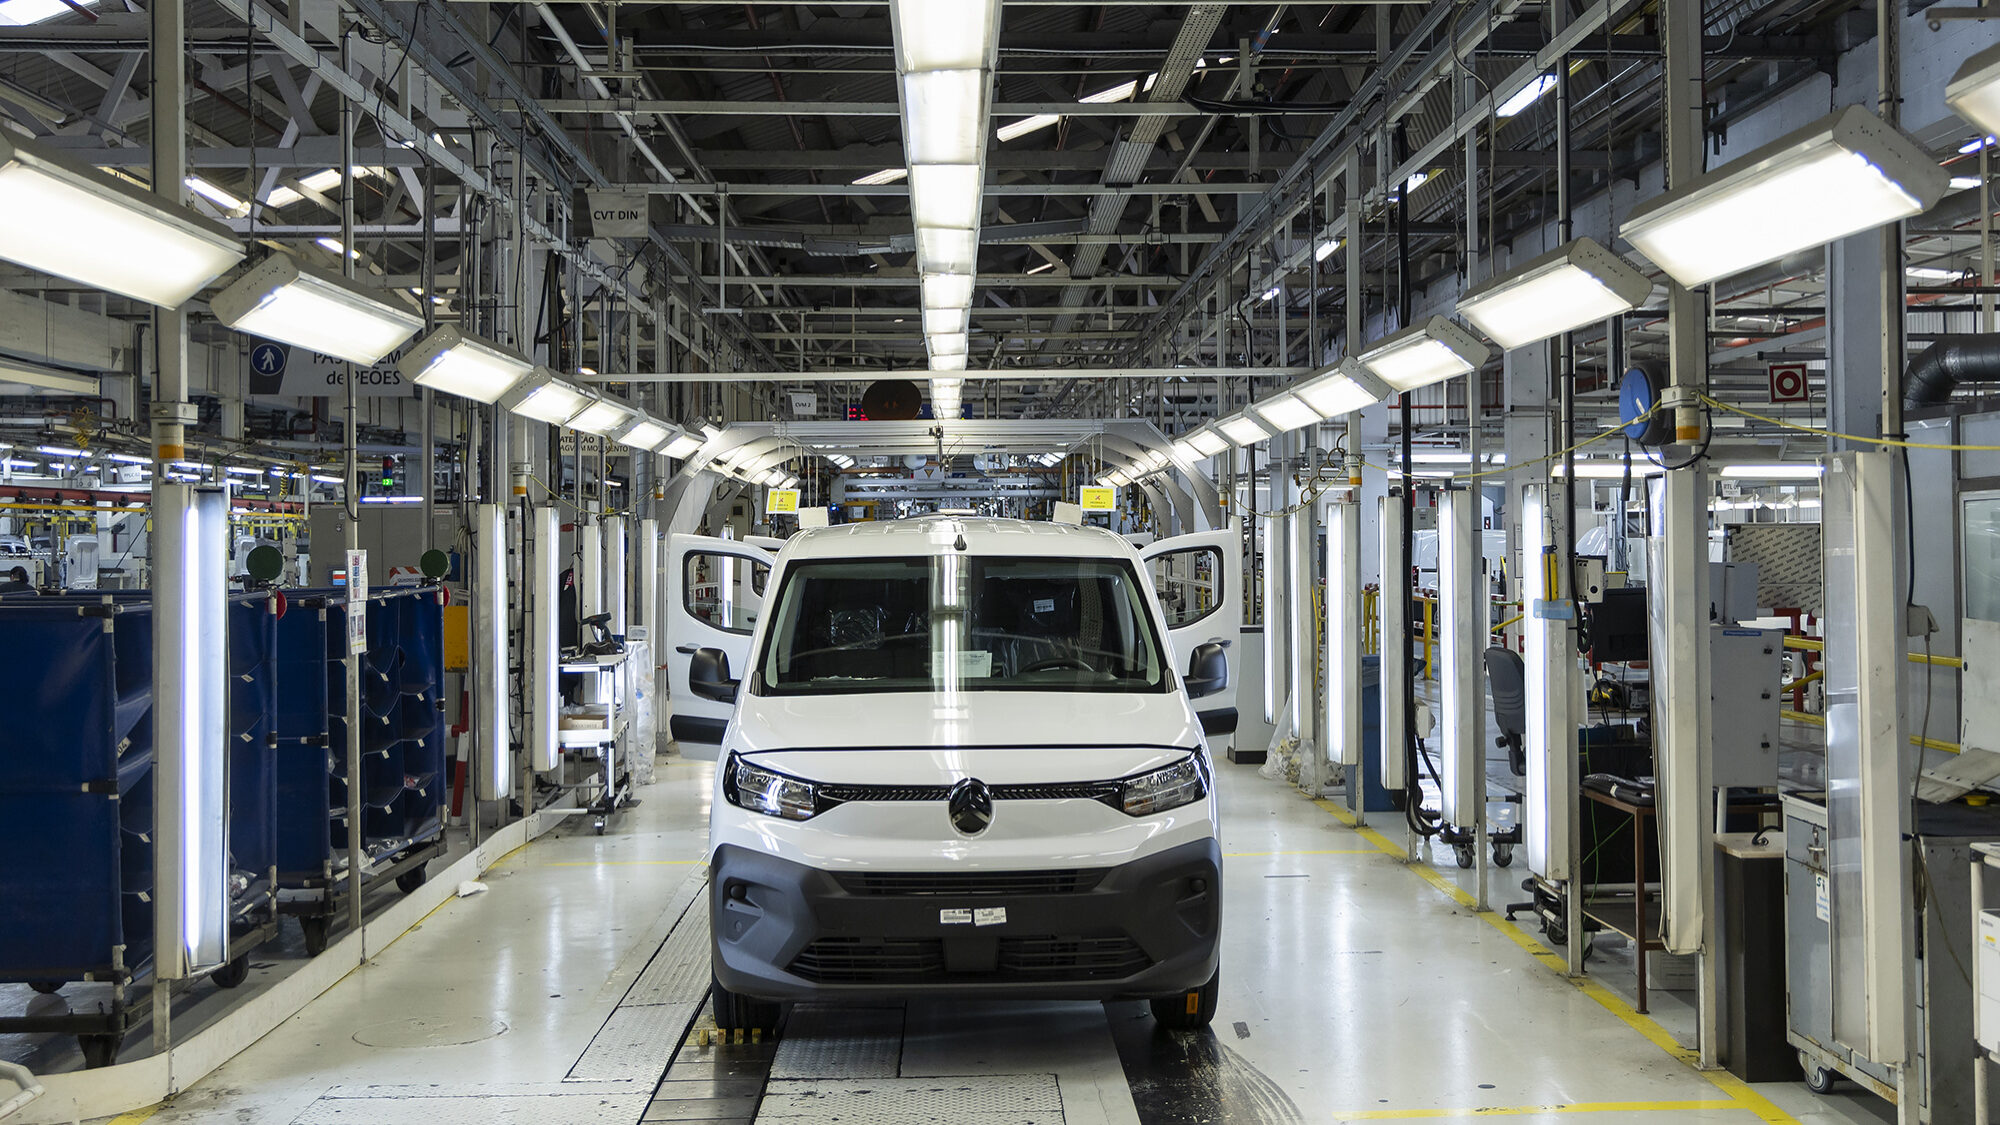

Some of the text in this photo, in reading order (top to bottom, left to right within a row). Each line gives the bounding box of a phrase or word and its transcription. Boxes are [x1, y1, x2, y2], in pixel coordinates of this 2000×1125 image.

[593, 210, 638, 220] CVT DIN
[326, 371, 345, 385] de
